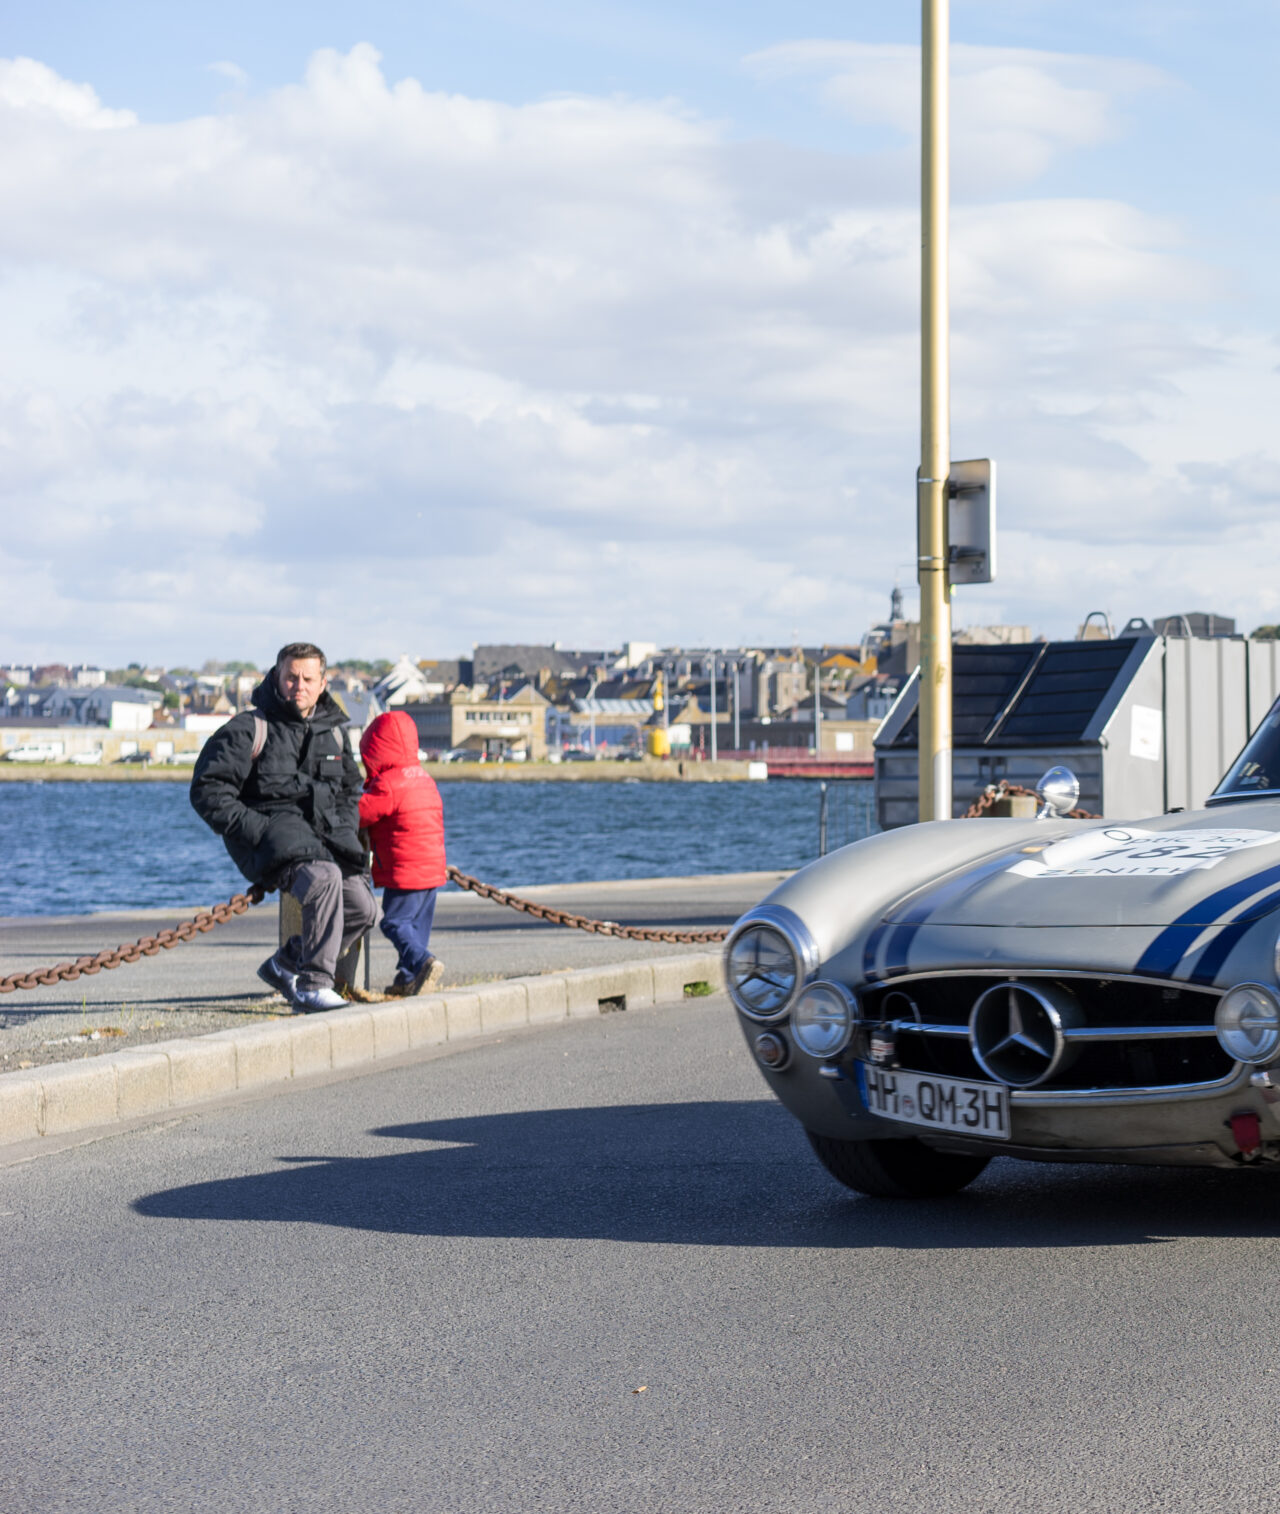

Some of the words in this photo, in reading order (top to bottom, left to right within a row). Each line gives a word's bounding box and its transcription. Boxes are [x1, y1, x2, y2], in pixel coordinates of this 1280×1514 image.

[1089, 845, 1232, 861] 182
[866, 1070, 899, 1114] HH
[917, 1081, 956, 1125] QM
[963, 1088, 1003, 1131] 3H
